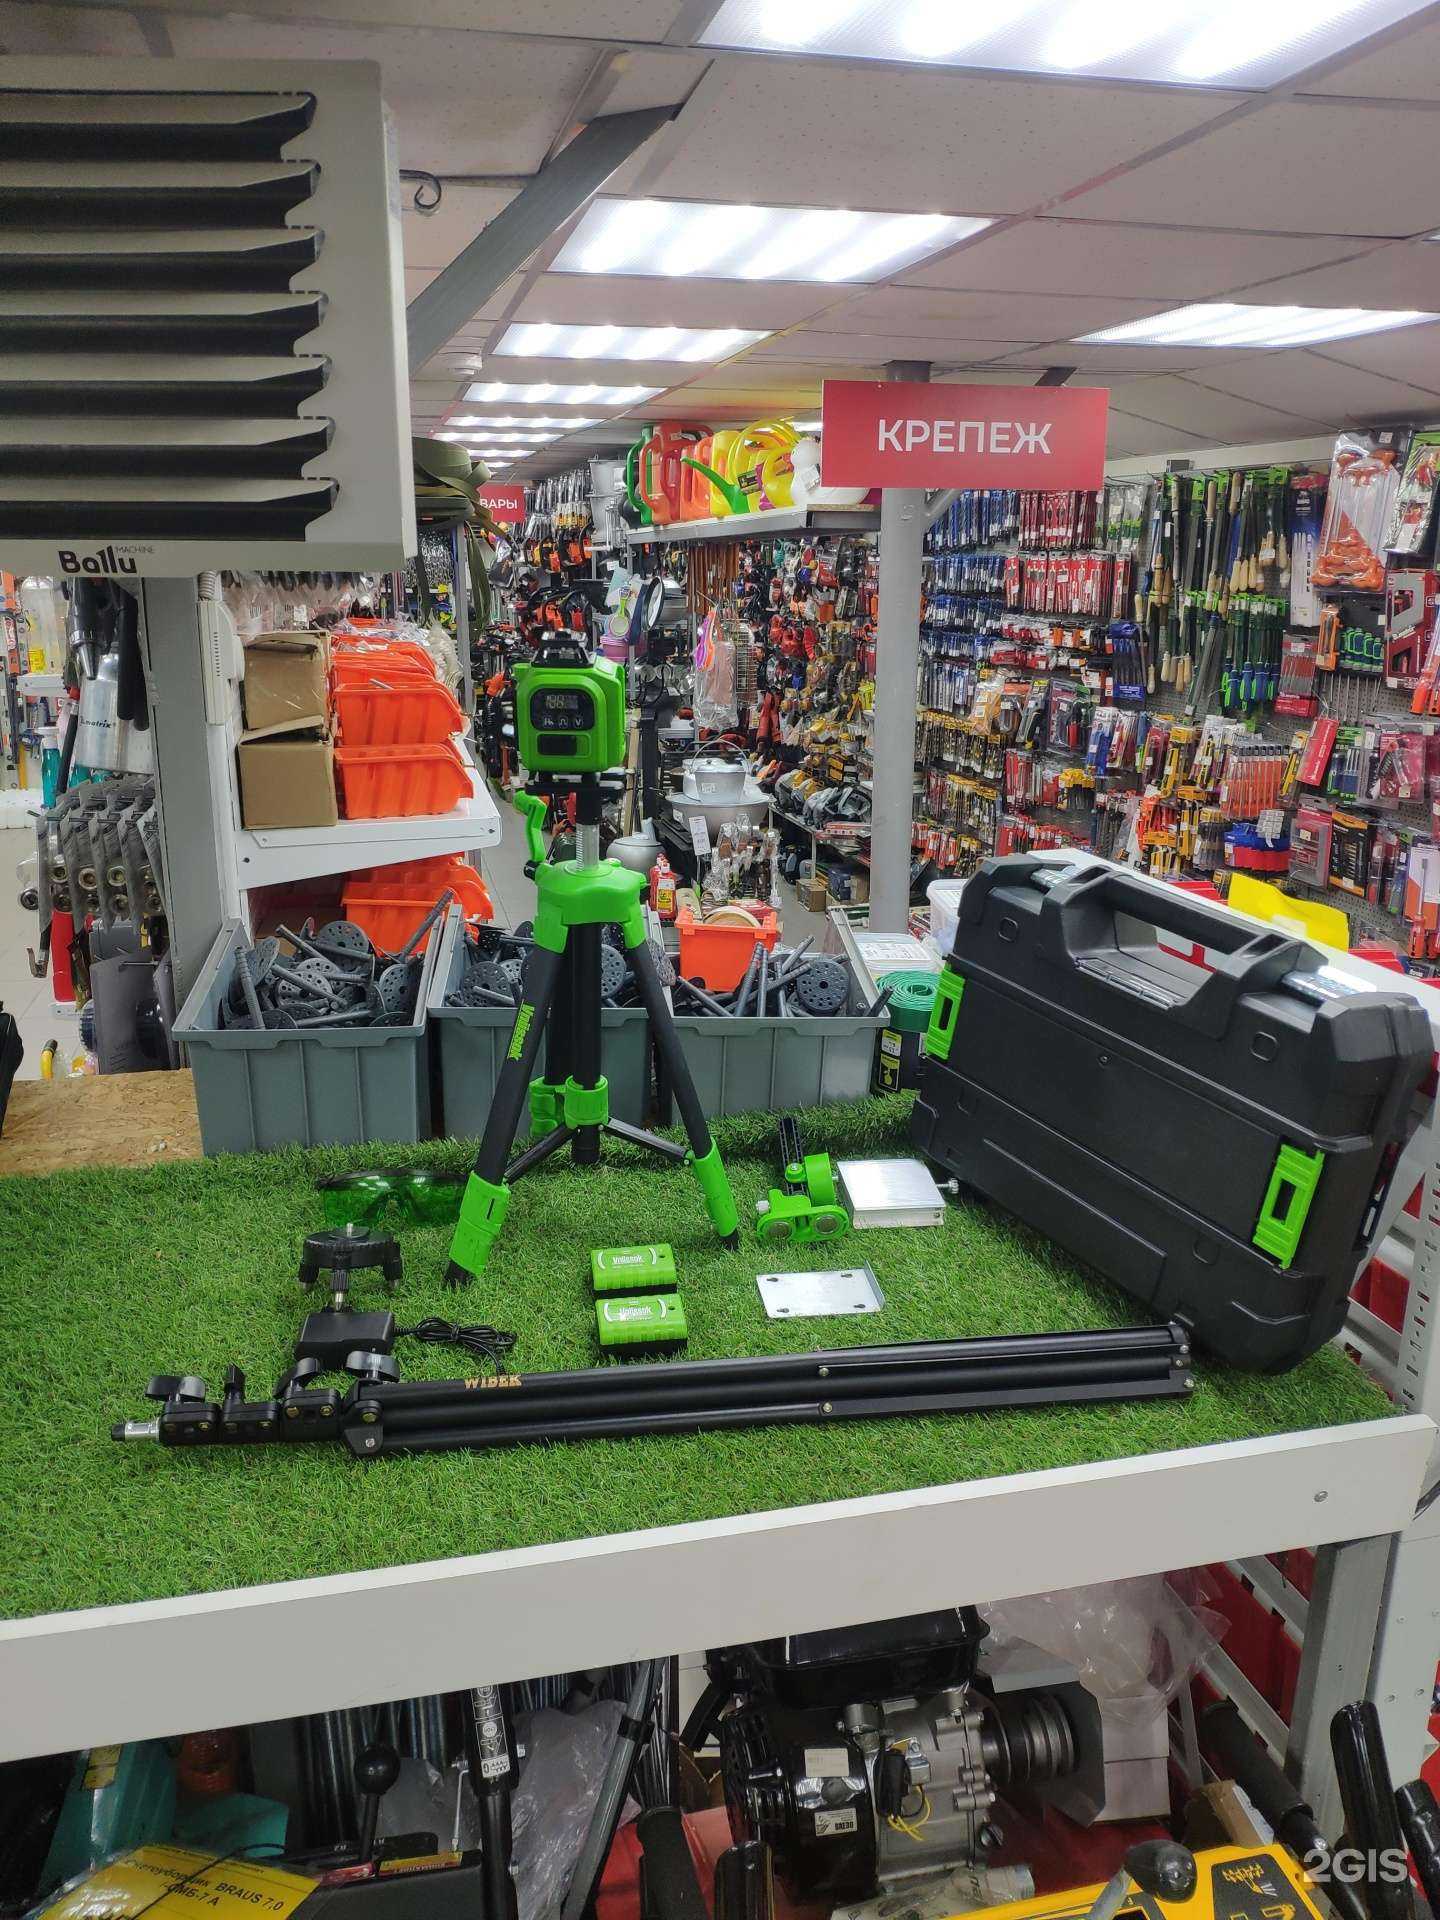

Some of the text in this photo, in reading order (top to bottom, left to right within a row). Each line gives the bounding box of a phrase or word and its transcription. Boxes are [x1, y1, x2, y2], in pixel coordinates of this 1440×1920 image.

[878, 419, 1052, 454] КРЕПЕЖ
[58, 545, 137, 574] Ballu
[214, 1882, 263, 1905] BRAUS
